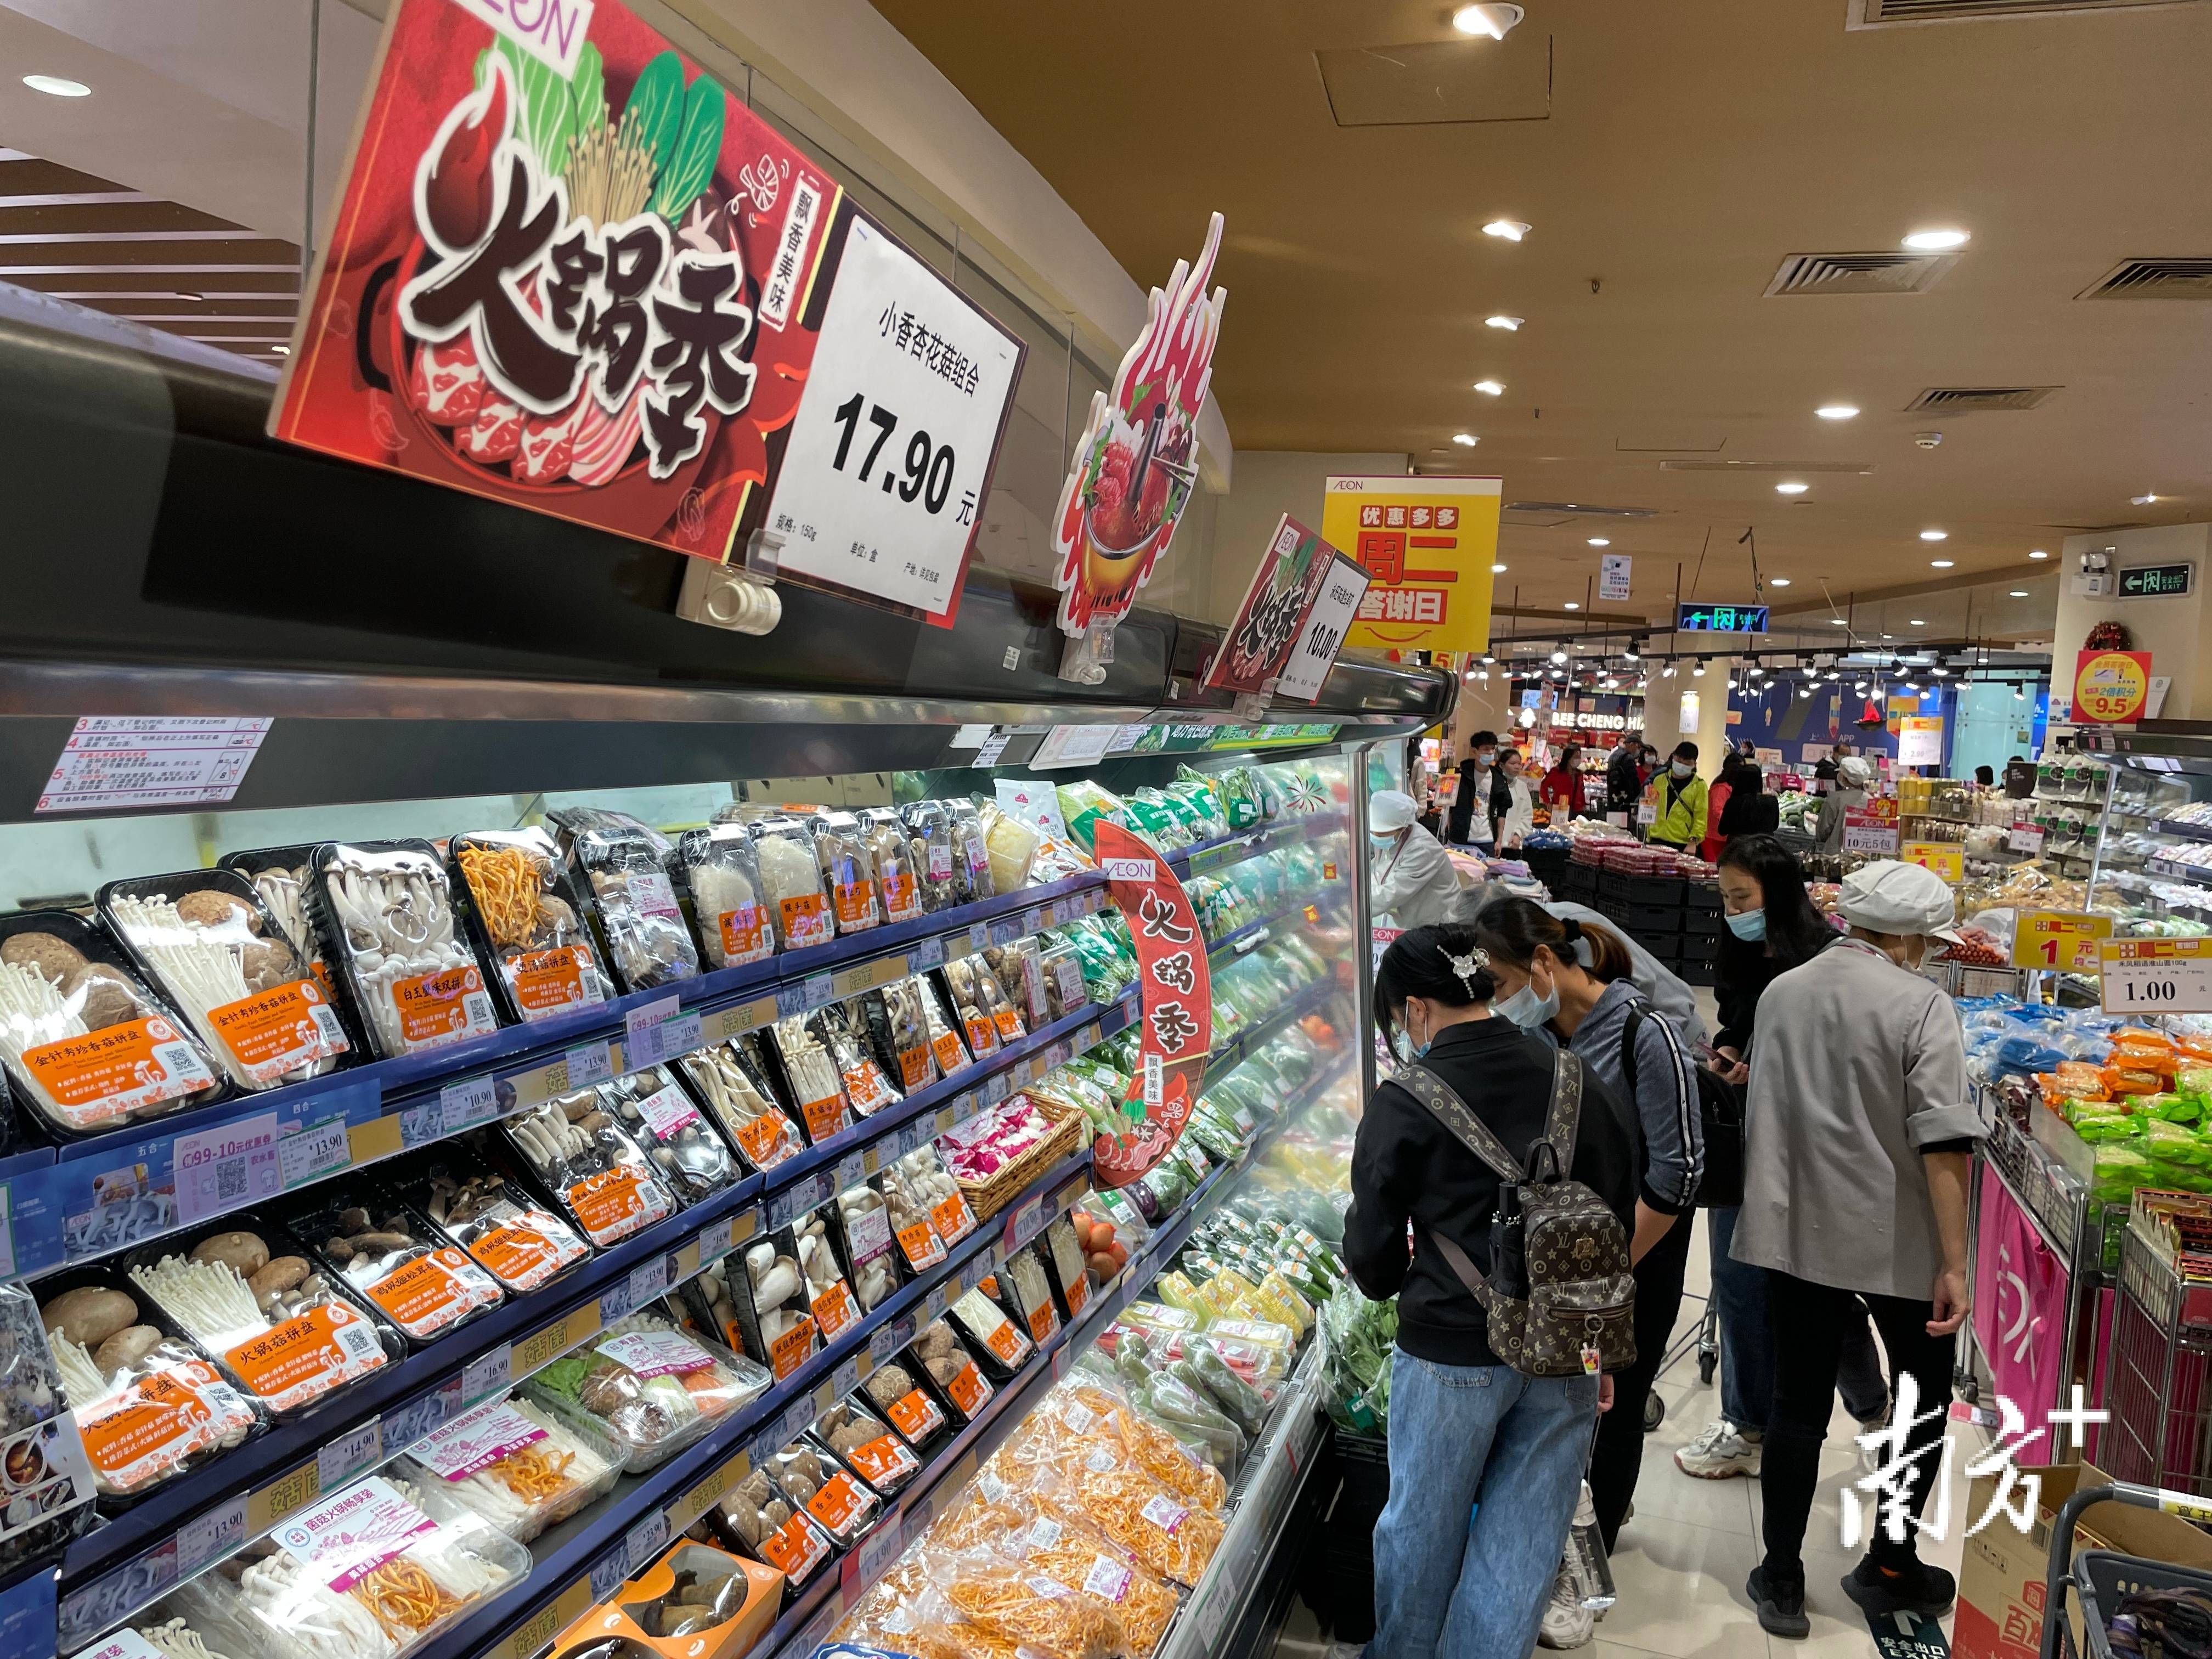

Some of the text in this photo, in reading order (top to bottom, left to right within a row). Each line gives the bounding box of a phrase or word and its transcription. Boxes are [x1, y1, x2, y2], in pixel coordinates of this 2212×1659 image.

[769, 189, 813, 313] 飘香美味
[878, 301, 980, 397] 小香杏花菇组合
[832, 392, 977, 527] 17.90 元
[1362, 506, 1457, 527] 优惠多多
[1356, 531, 1458, 585] 周二
[2162, 574, 2183, 584] 安全出口
[1358, 590, 1441, 622] 答谢日
[2095, 697, 2127, 713] 9.5
[1551, 712, 1575, 727] BEE
[1577, 713, 1625, 730] CHENG
[1838, 734, 1855, 742] APP
[1848, 838, 1891, 850] 10元5包
[2040, 940, 2093, 964] 1 元
[1141, 889, 1197, 1053] 火锅季
[403, 976, 461, 1001] 白玉蟹味双拼
[2125, 981, 2176, 1001] 1.00
[217, 991, 300, 1026] 金针秀珍香菇拼盘
[721, 1006, 754, 1035] 菇菌
[34, 1030, 142, 1067] 金针秀珍香菇拼盘
[545, 1067, 569, 1095] 菇
[1148, 1057, 1159, 1101] 飘香美味
[137, 1142, 168, 1156] 五合一
[240, 1321, 318, 1365] 火锅菇拼盘
[524, 1322, 569, 1368] 菇菌
[464, 1454, 496, 1474] 美味组合
[304, 1488, 375, 1532] 菌菇火锅畅享装
[815, 1491, 833, 1510] 香菇
[348, 1554, 384, 1581] 美味组合
[1881, 1637, 1945, 1657] 安全出口
